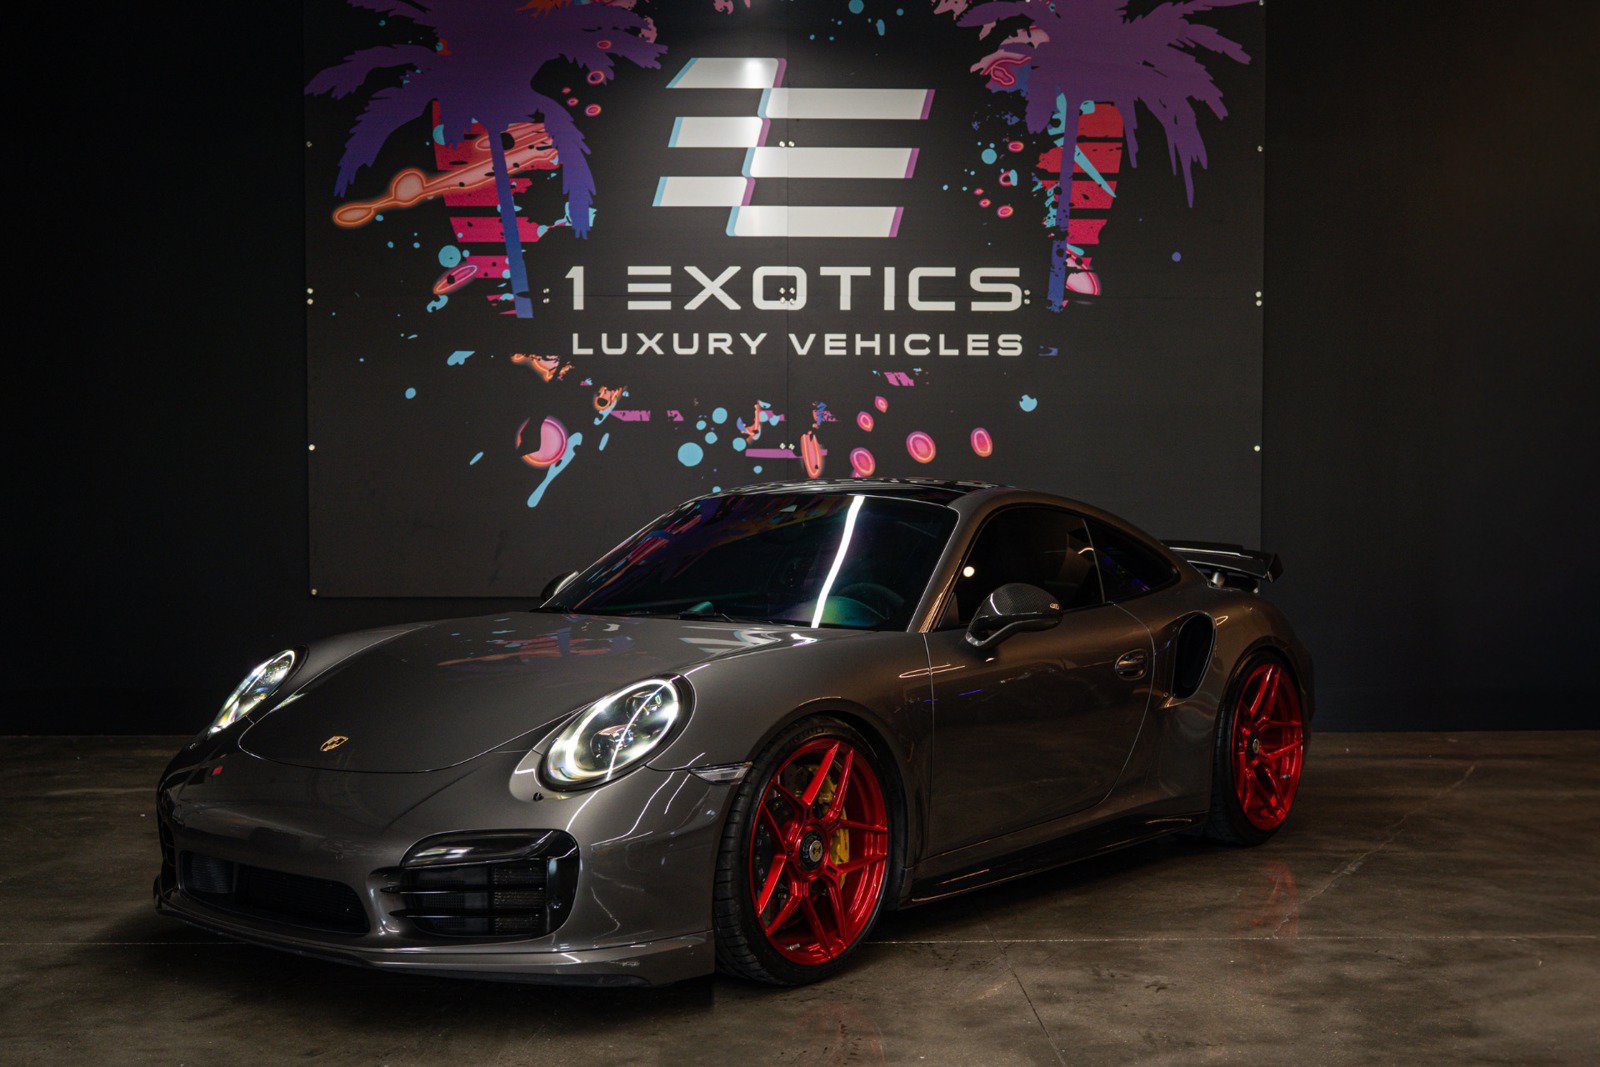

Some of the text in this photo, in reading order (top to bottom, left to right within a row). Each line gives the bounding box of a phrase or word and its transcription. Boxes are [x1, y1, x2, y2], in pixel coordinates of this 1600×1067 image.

[565, 265, 1022, 311] 1 EXOTICS
[572, 332, 1023, 356] LUXURY VEHICLES
